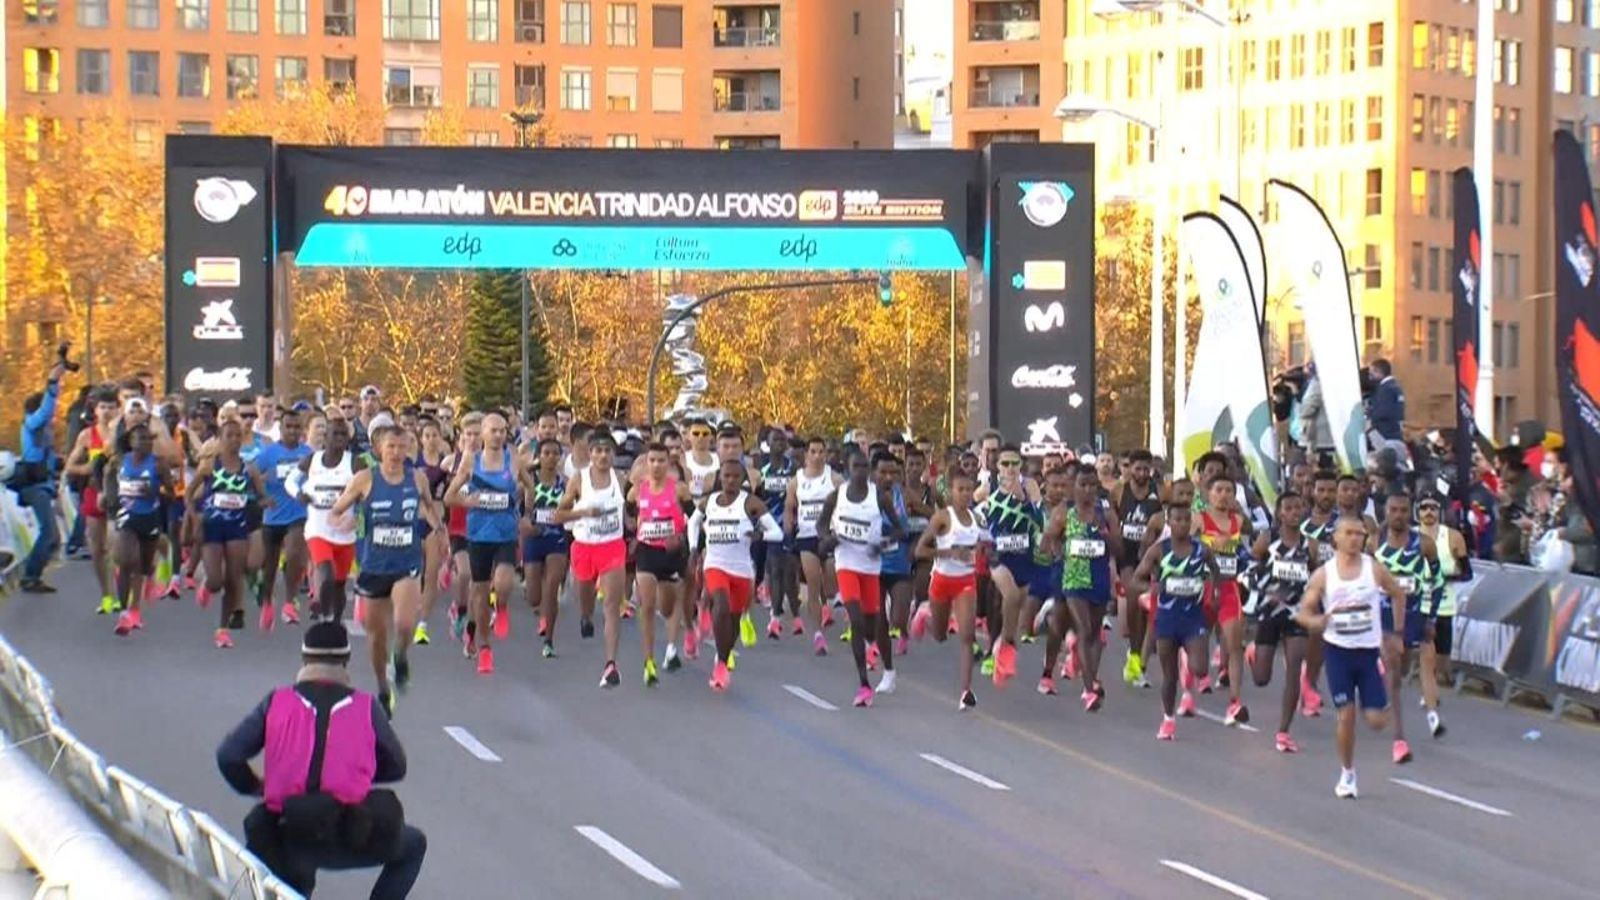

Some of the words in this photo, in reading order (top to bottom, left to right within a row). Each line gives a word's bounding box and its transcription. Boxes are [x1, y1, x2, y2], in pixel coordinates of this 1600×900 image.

[324, 185, 367, 216] 40
[368, 184, 485, 215] MARATÓN
[488, 191, 596, 216] VALENCIA
[595, 192, 694, 217] TRINIDAD
[695, 193, 797, 217] ALFONSO
[804, 194, 832, 215] edp
[885, 204, 943, 215] EDITION
[443, 232, 482, 260] edp
[779, 233, 818, 262] edp
[844, 524, 862, 537] 135
